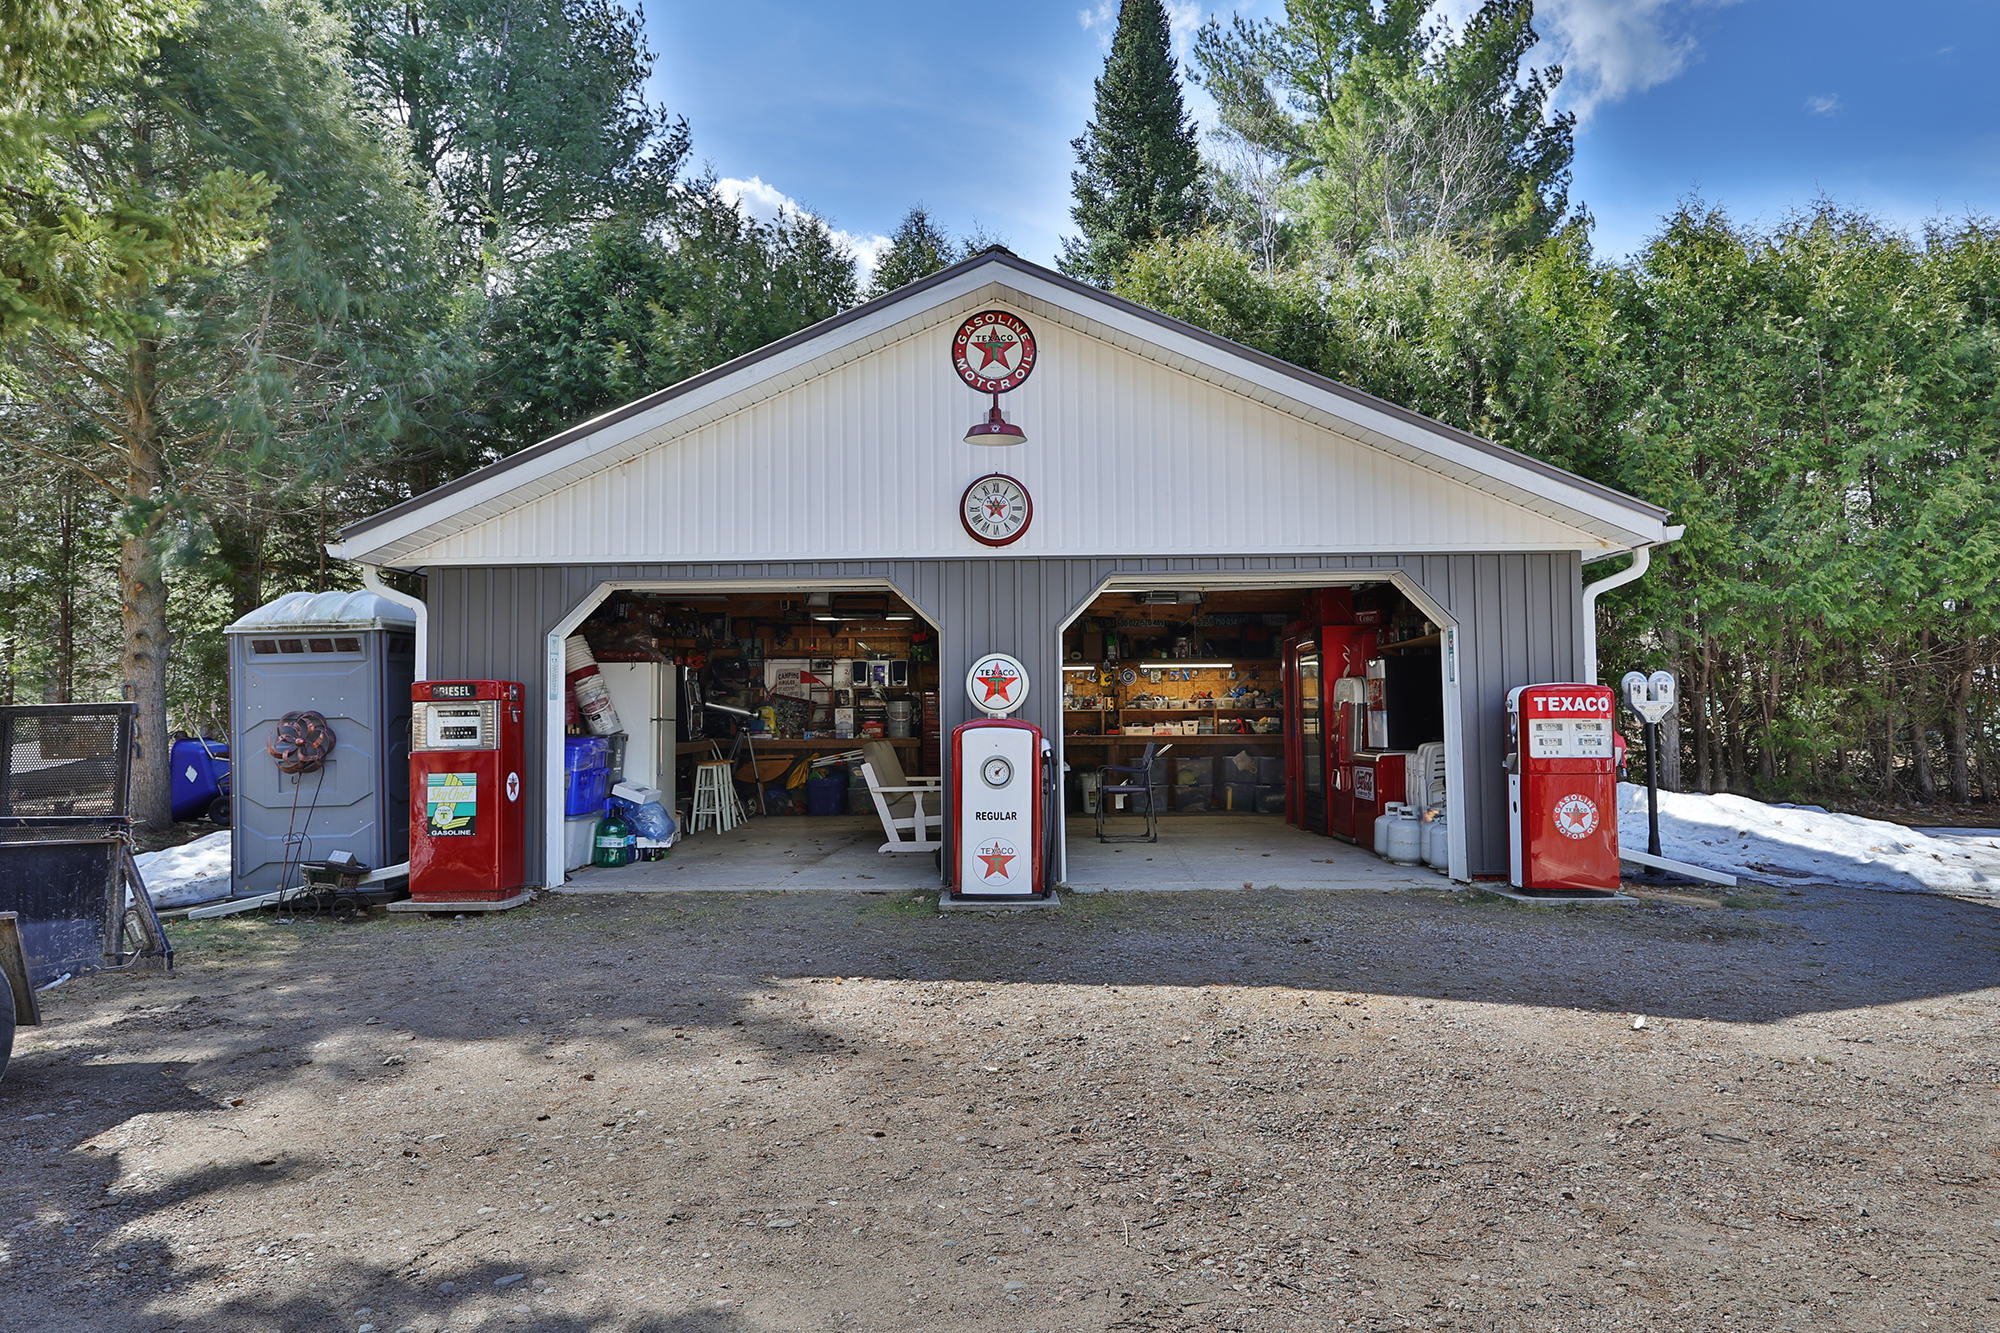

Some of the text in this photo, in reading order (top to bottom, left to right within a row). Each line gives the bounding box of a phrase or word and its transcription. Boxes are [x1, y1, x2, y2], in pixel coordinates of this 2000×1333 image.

[957, 314, 1030, 345] GASOLINE
[975, 334, 1014, 342] TEXACO
[1015, 354, 1033, 379] OIL
[778, 672, 800, 680] CAMPING
[439, 686, 471, 697] DIESEL
[1533, 697, 1609, 712] TEXACO
[1554, 794, 1598, 814] GASOLINE
[975, 811, 1017, 821] REGULAR
[1554, 820, 1600, 839] MOTOR OIL
[980, 847, 1014, 855] TEXACO
